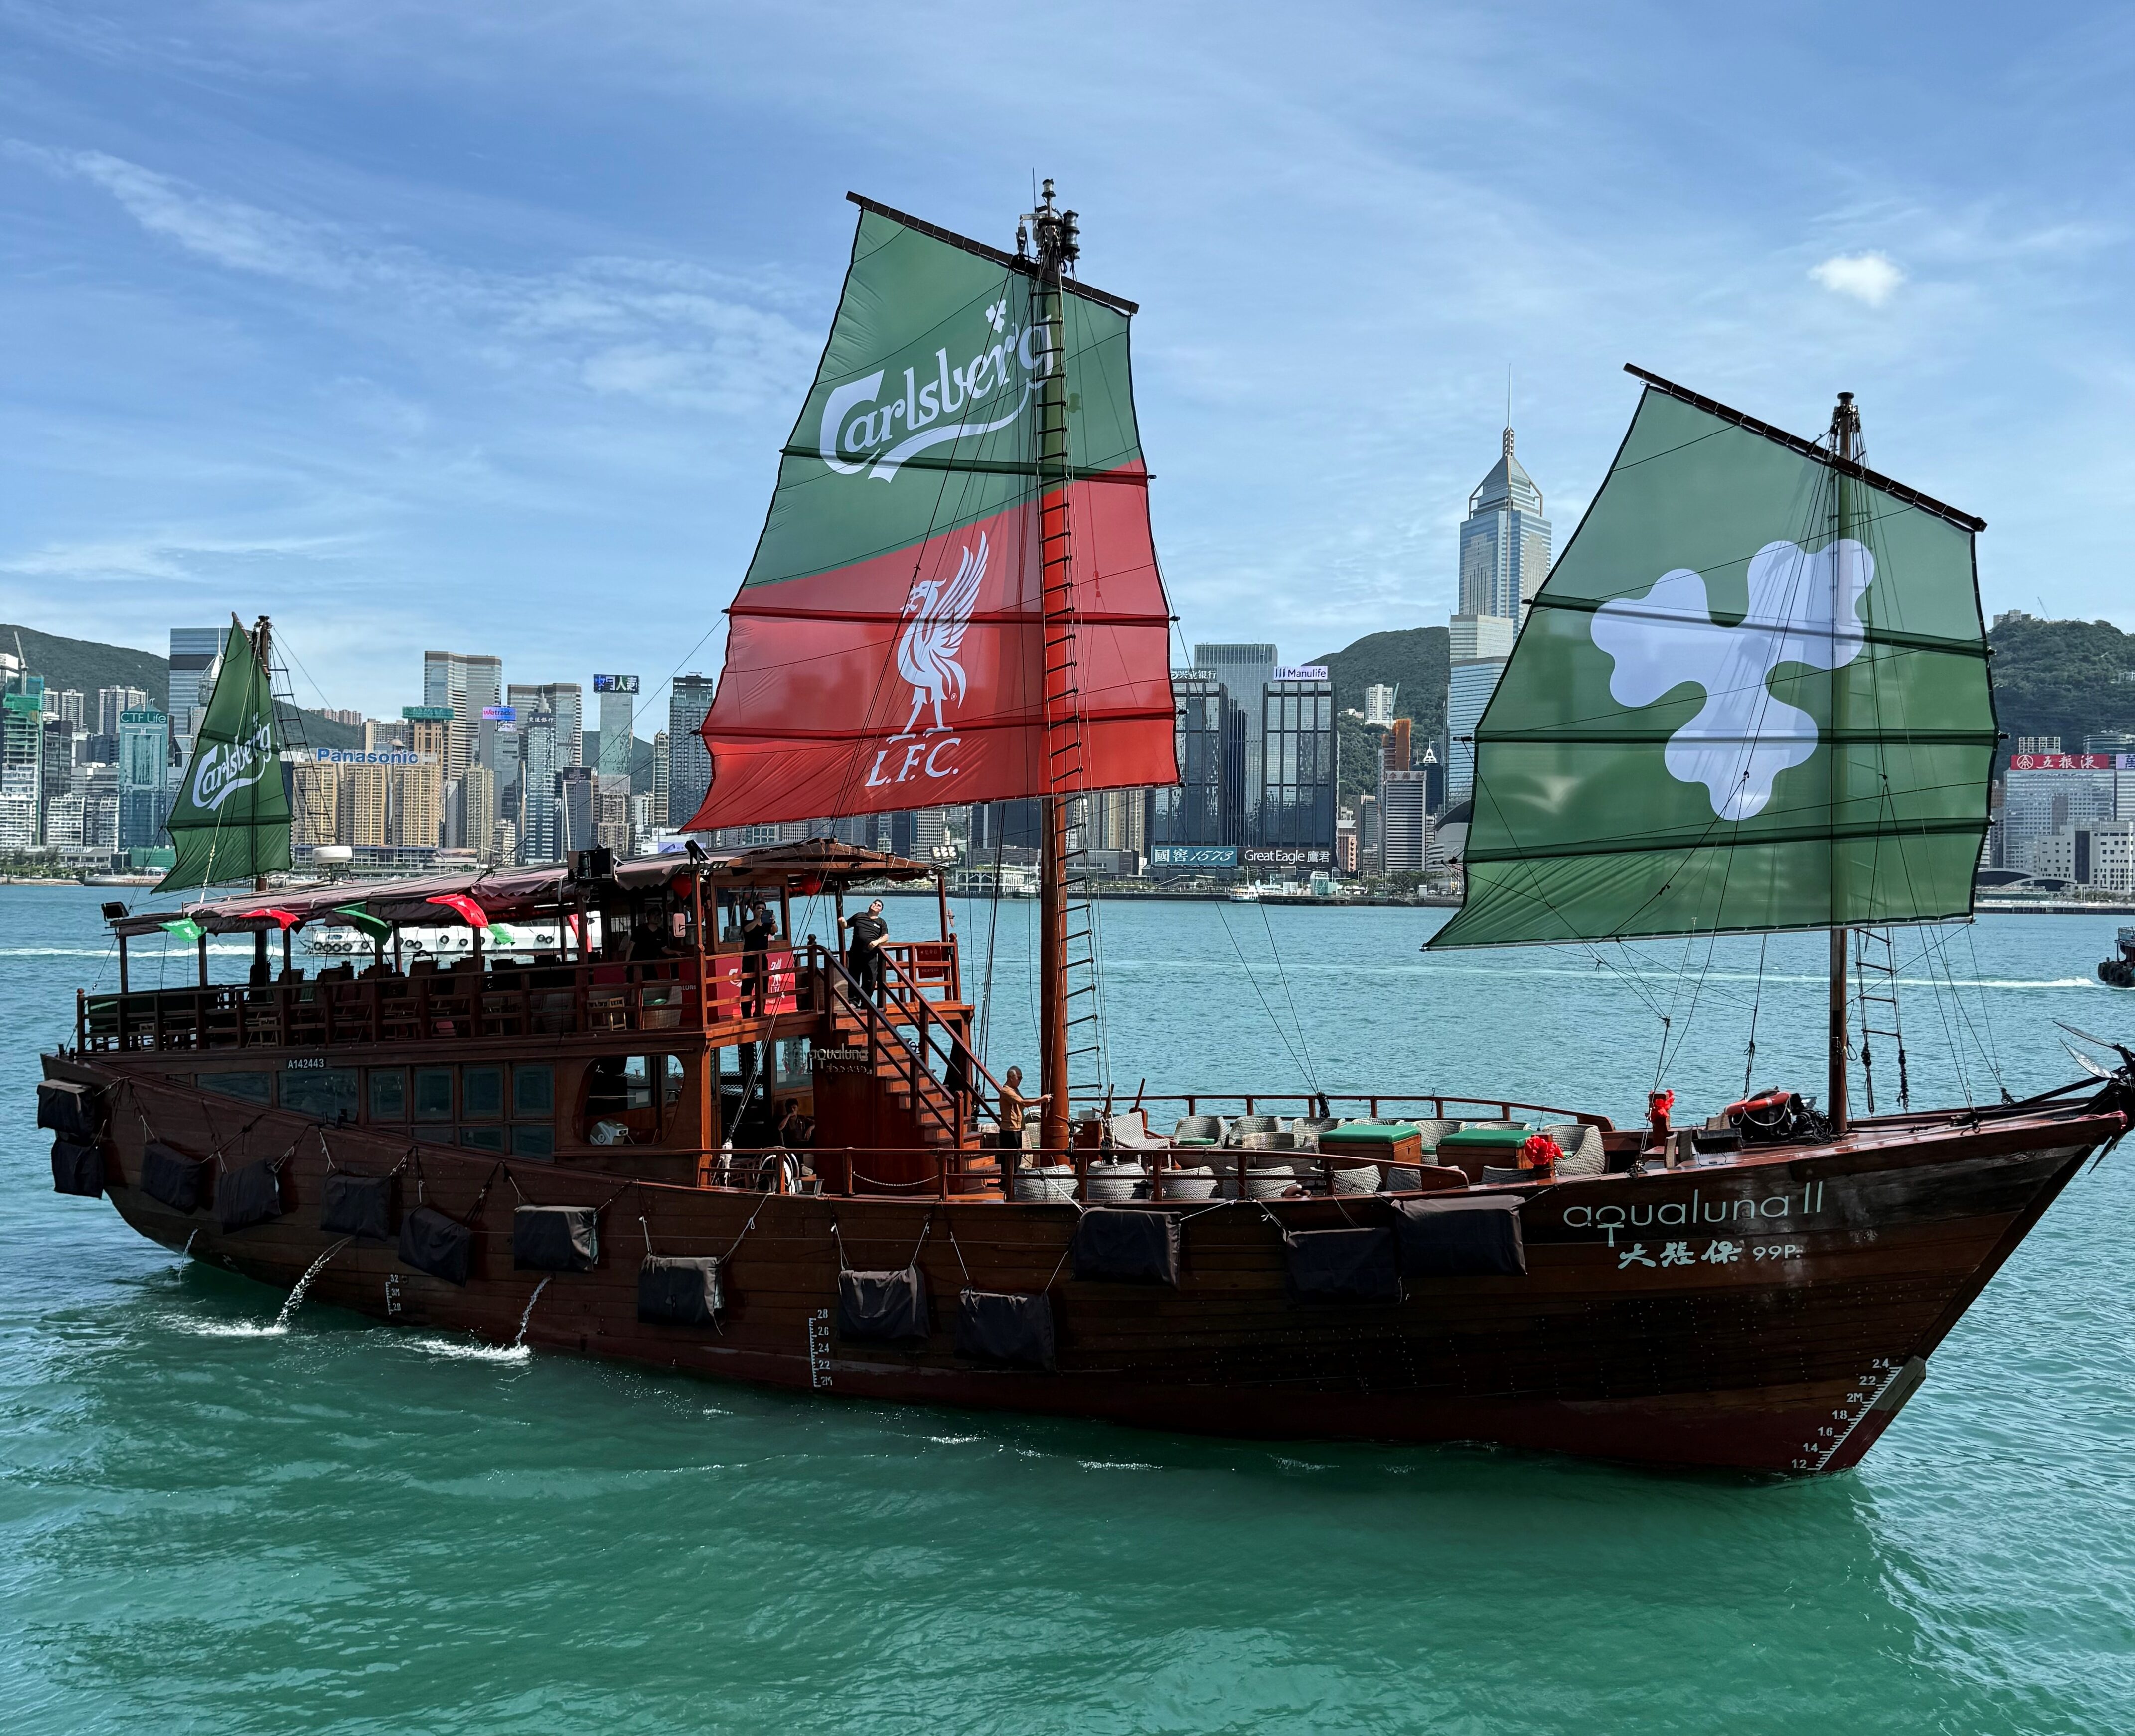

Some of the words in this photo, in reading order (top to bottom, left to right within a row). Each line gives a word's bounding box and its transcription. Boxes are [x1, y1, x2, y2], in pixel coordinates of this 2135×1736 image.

[819, 315, 1054, 483] Carlsberg
[1288, 668, 1326, 678] Manulife
[120, 712, 144, 722] CTF
[147, 713, 167, 723] Life
[317, 748, 419, 764] Panasonic
[864, 738, 961, 787] L.F.C.
[192, 723, 272, 812] Carlsberg
[1189, 850, 1234, 861] 1573
[1244, 850, 1275, 861] Great
[1275, 850, 1305, 864] Eagle
[1307, 851, 1331, 863] 鷹君
[288, 1058, 324, 1069] A142443
[809, 1043, 869, 1069] aqualuna
[1563, 1189, 1789, 1247] aqualuna
[1846, 1393, 1863, 1403] 2M
